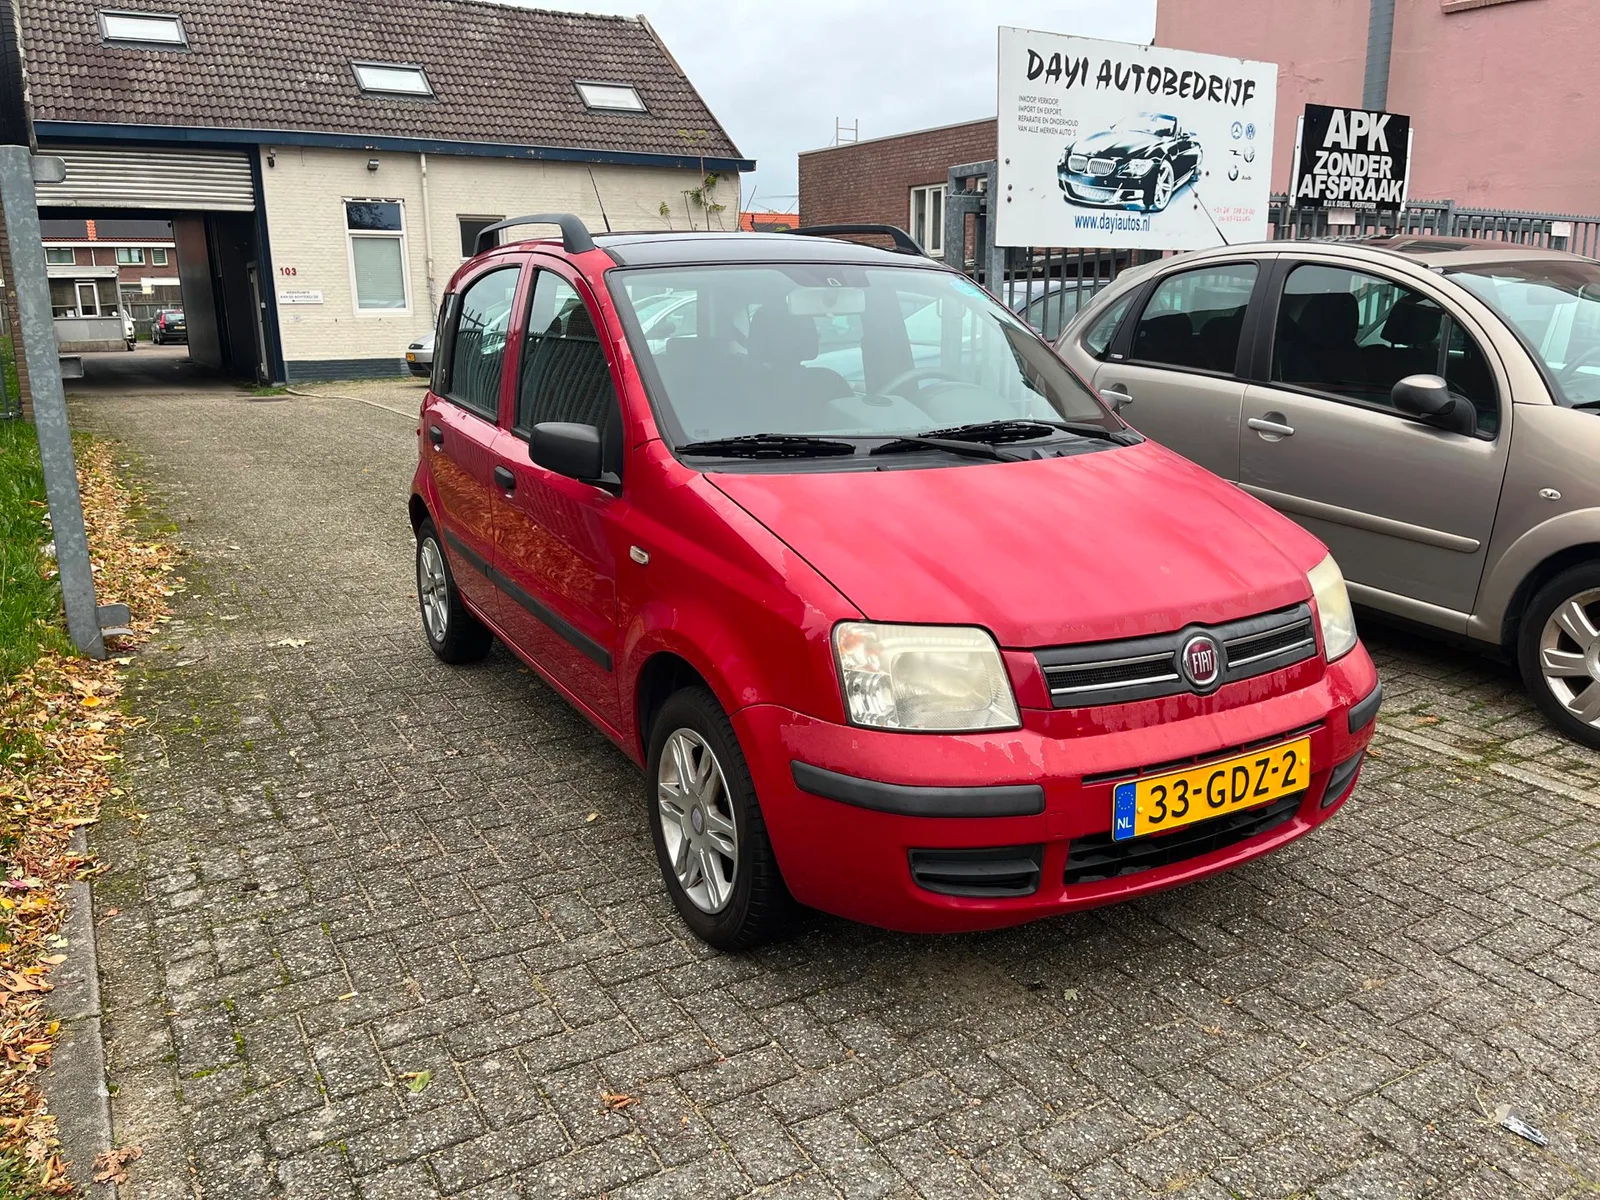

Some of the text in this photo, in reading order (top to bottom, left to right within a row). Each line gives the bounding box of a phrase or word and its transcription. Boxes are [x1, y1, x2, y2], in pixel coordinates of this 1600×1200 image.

[1027, 49, 1256, 108] DAYI AUTOBEDRIJF
[1049, 117, 1079, 127] ONDERHOUD
[1322, 109, 1392, 152] APK
[1313, 150, 1393, 179] ZONDER
[1297, 174, 1404, 203] AFSPRAAK
[1074, 212, 1151, 234] www.dayiautos.nl
[280, 267, 297, 276] 103
[1191, 649, 1214, 675] FIAT
[1149, 750, 1297, 824] 33-GDZ-2
[1117, 817, 1133, 831] NL
